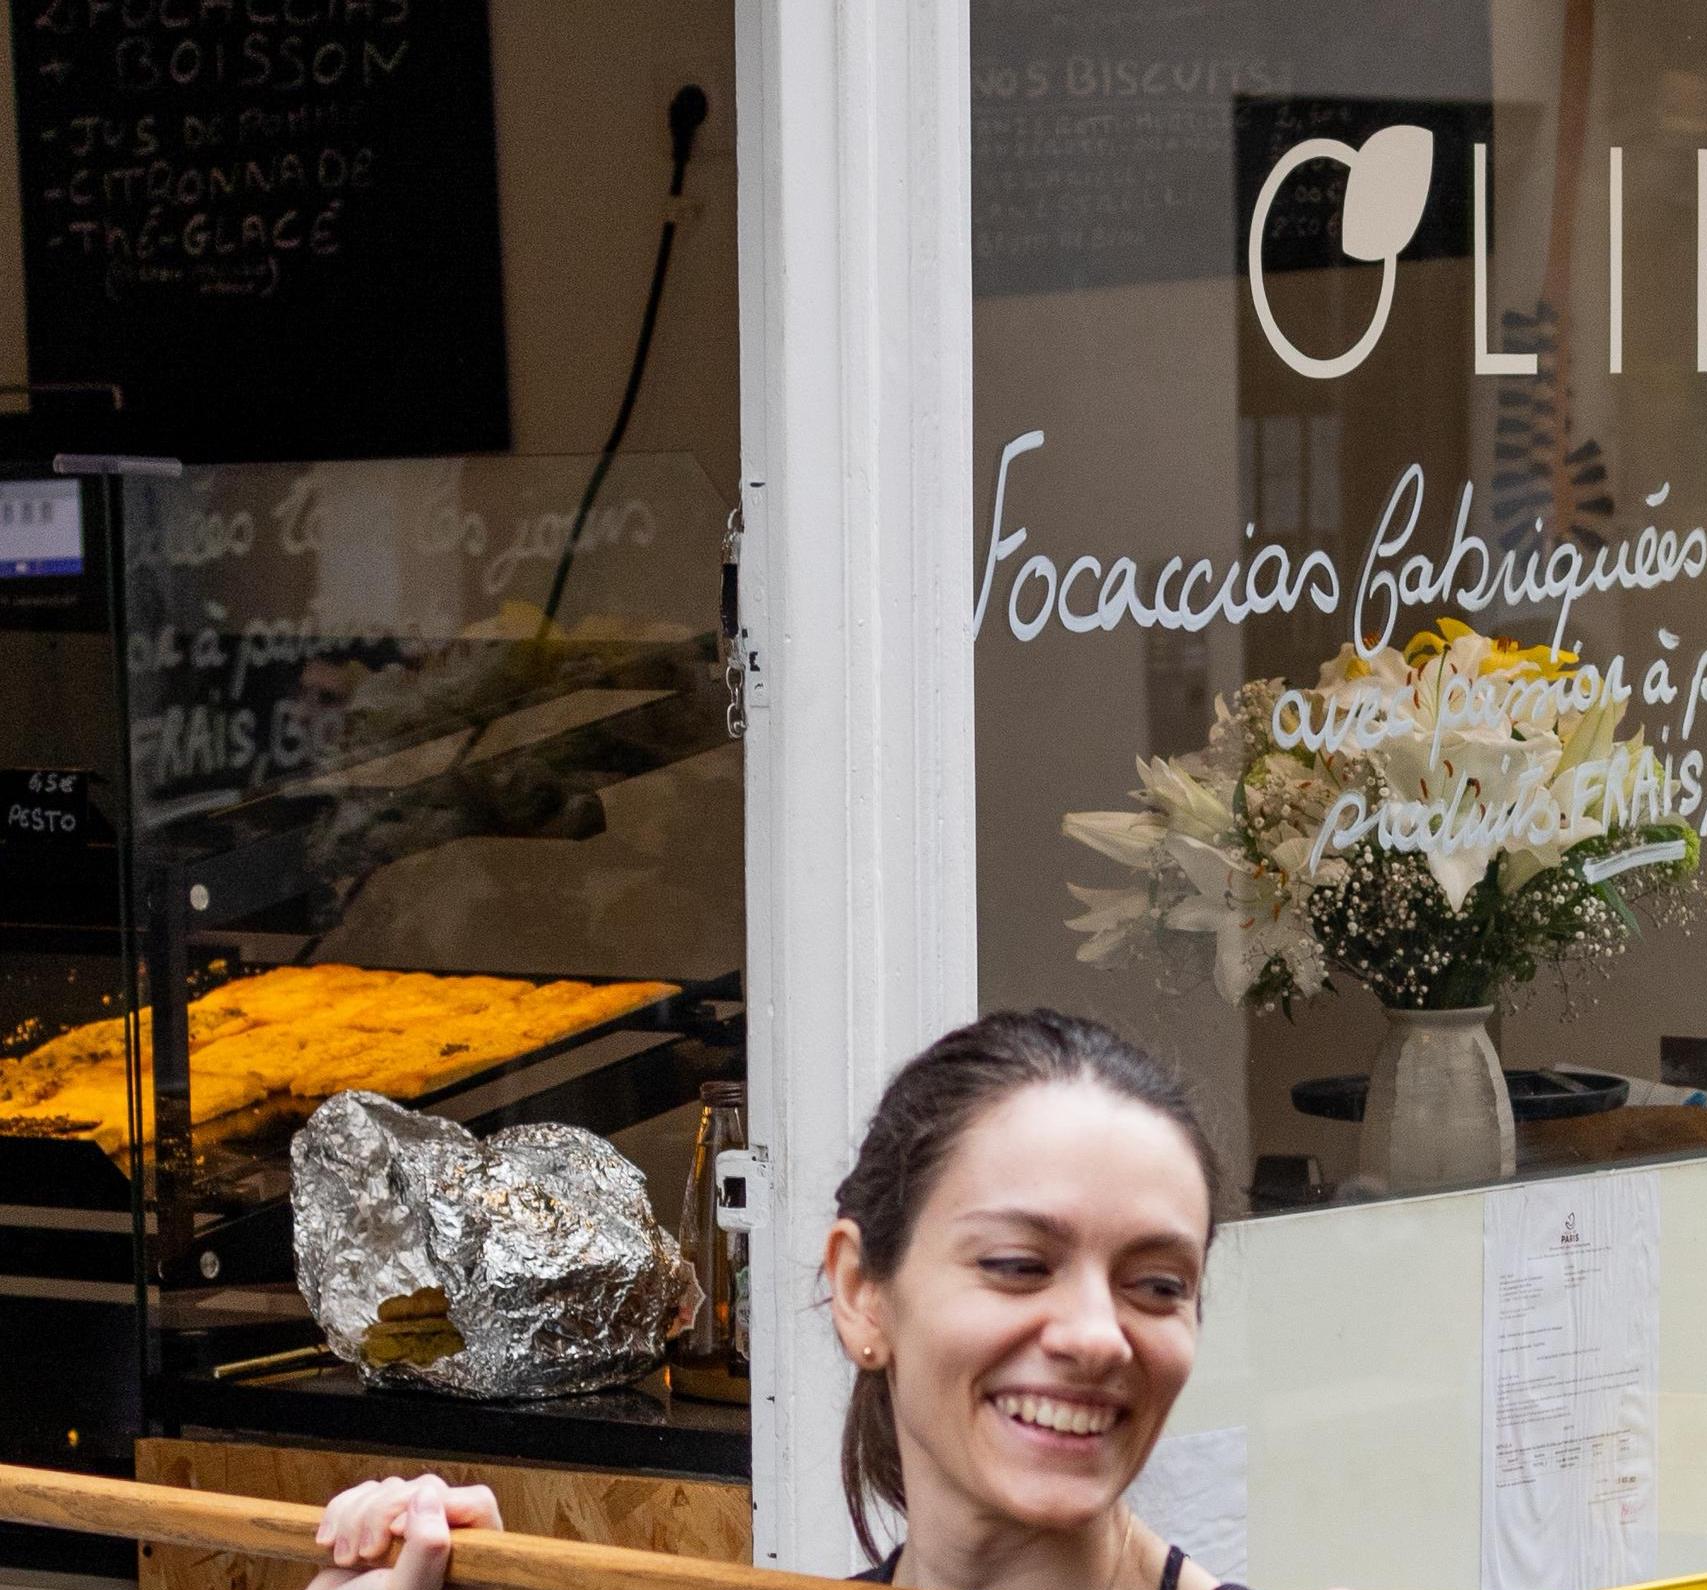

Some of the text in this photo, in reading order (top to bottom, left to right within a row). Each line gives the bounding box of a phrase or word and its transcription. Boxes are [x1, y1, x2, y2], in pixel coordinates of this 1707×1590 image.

[115, 32, 410, 91] BOISSON
[972, 430, 1340, 642] Focaccias
[1354, 463, 1707, 662] fabriquées
[1643, 628, 1679, 706] à
[8, 802, 77, 832] PESTO
